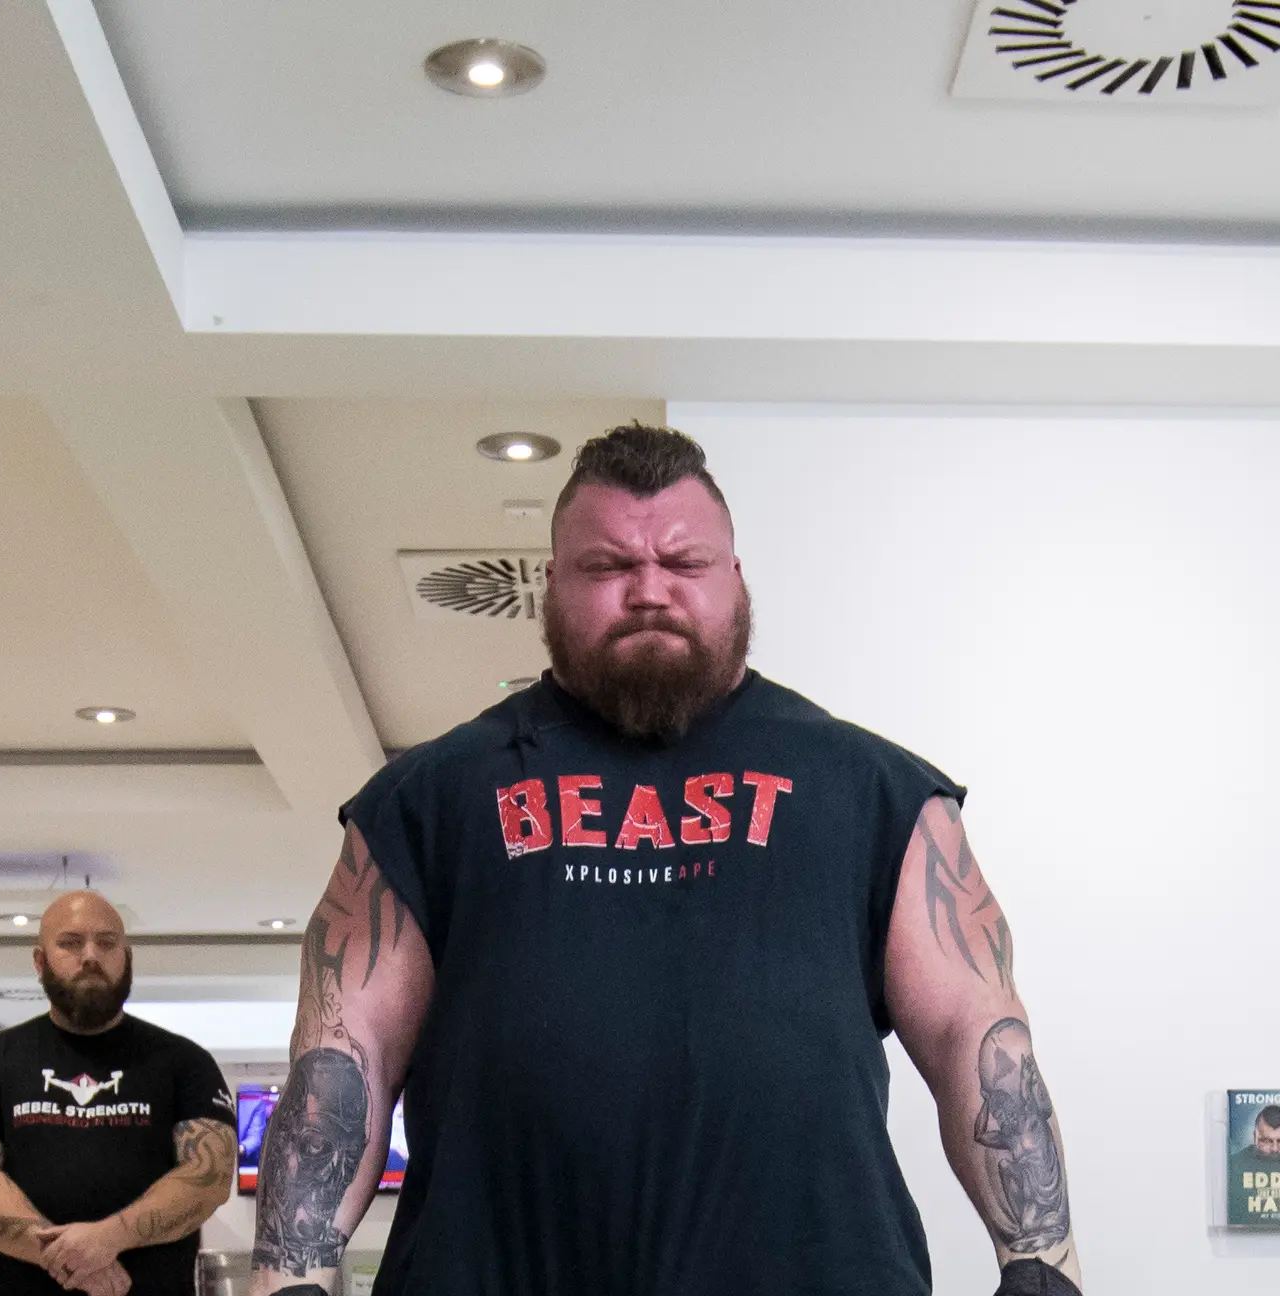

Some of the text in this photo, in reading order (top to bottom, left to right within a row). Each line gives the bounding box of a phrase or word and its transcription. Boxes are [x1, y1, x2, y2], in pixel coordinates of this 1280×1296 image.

[496, 770, 793, 860] BEAST
[13, 1101, 151, 1119] REBEL STRENGTH
